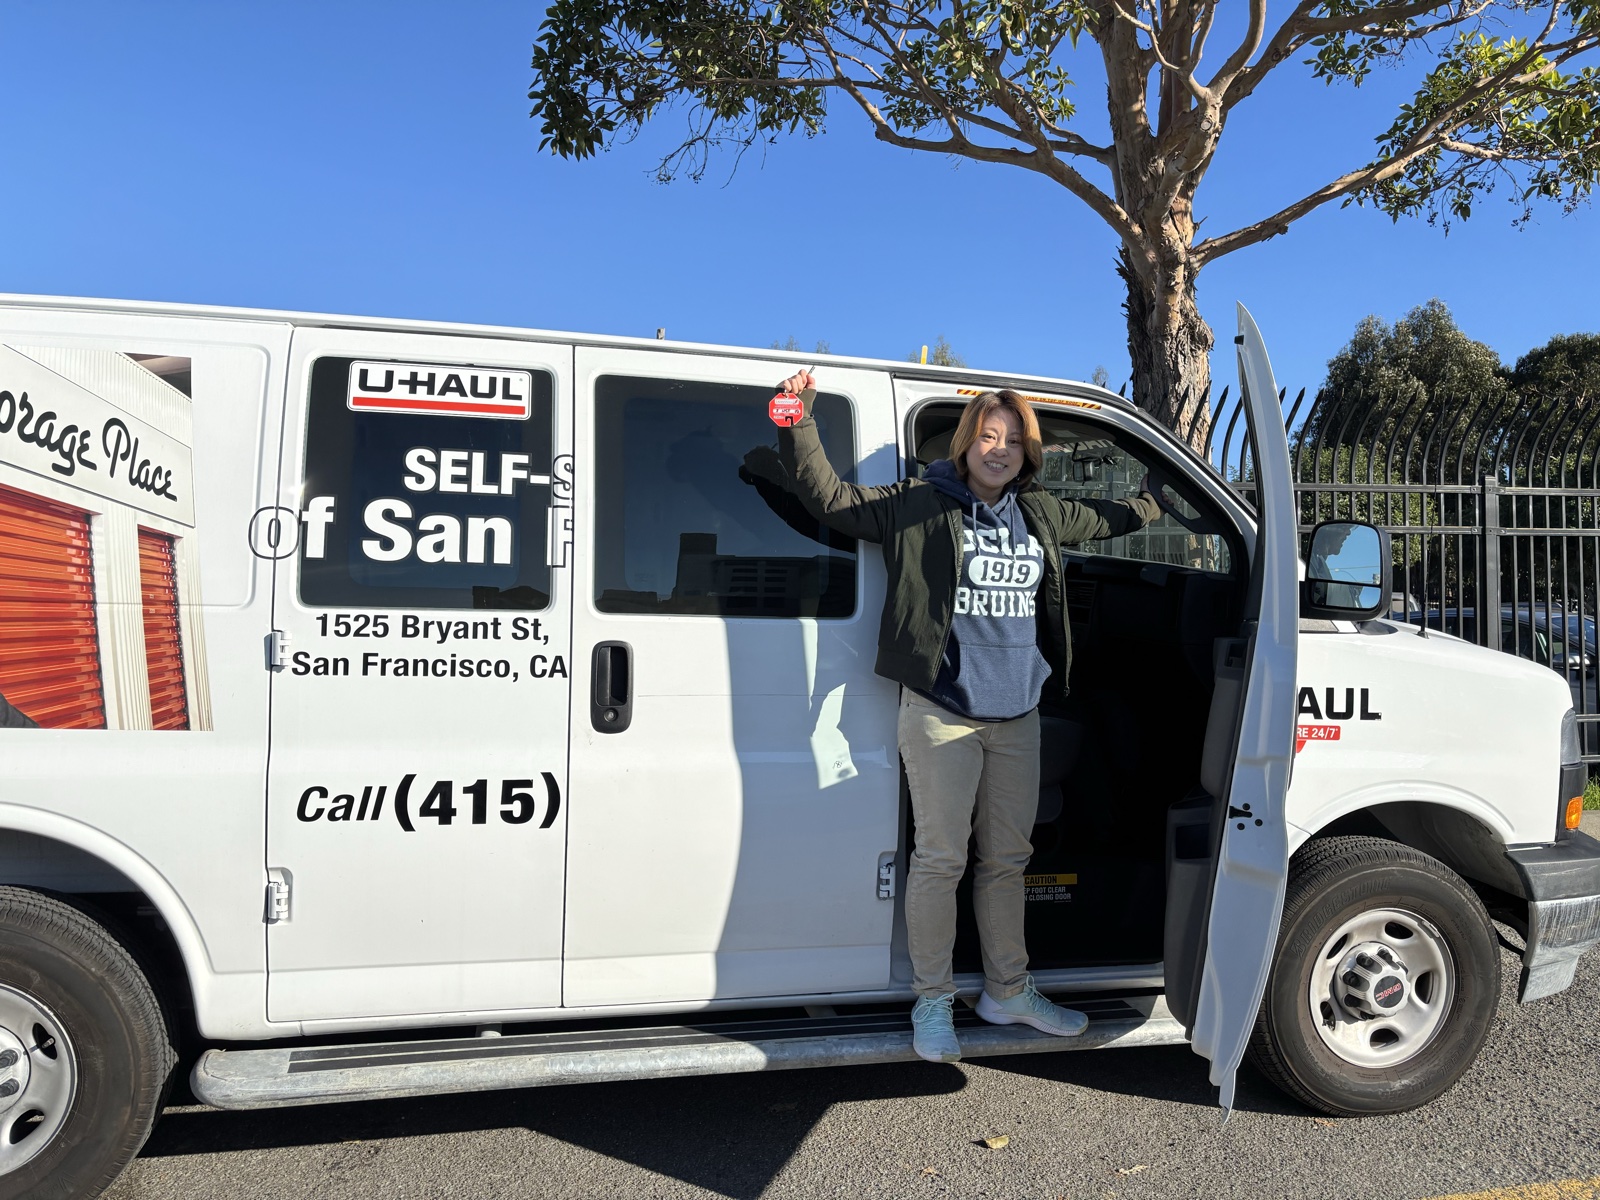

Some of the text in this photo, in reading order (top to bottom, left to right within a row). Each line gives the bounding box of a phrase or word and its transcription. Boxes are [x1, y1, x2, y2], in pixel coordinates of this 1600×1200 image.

[358, 368, 523, 401] U-HAUL
[0, 390, 178, 502] orage Place
[248, 496, 336, 560] of
[360, 497, 514, 565] San
[981, 559, 1031, 585] 1919
[954, 586, 1037, 617] BRUINS
[316, 613, 549, 645] 1525 Bryant St,
[291, 651, 568, 682] San Francisco, CA
[1297, 686, 1382, 720] AUL
[1297, 727, 1309, 738] RE
[296, 772, 561, 832] Call (415)
[1024, 876, 1057, 885] CAUTION
[1047, 886, 1066, 894] CLEAR
